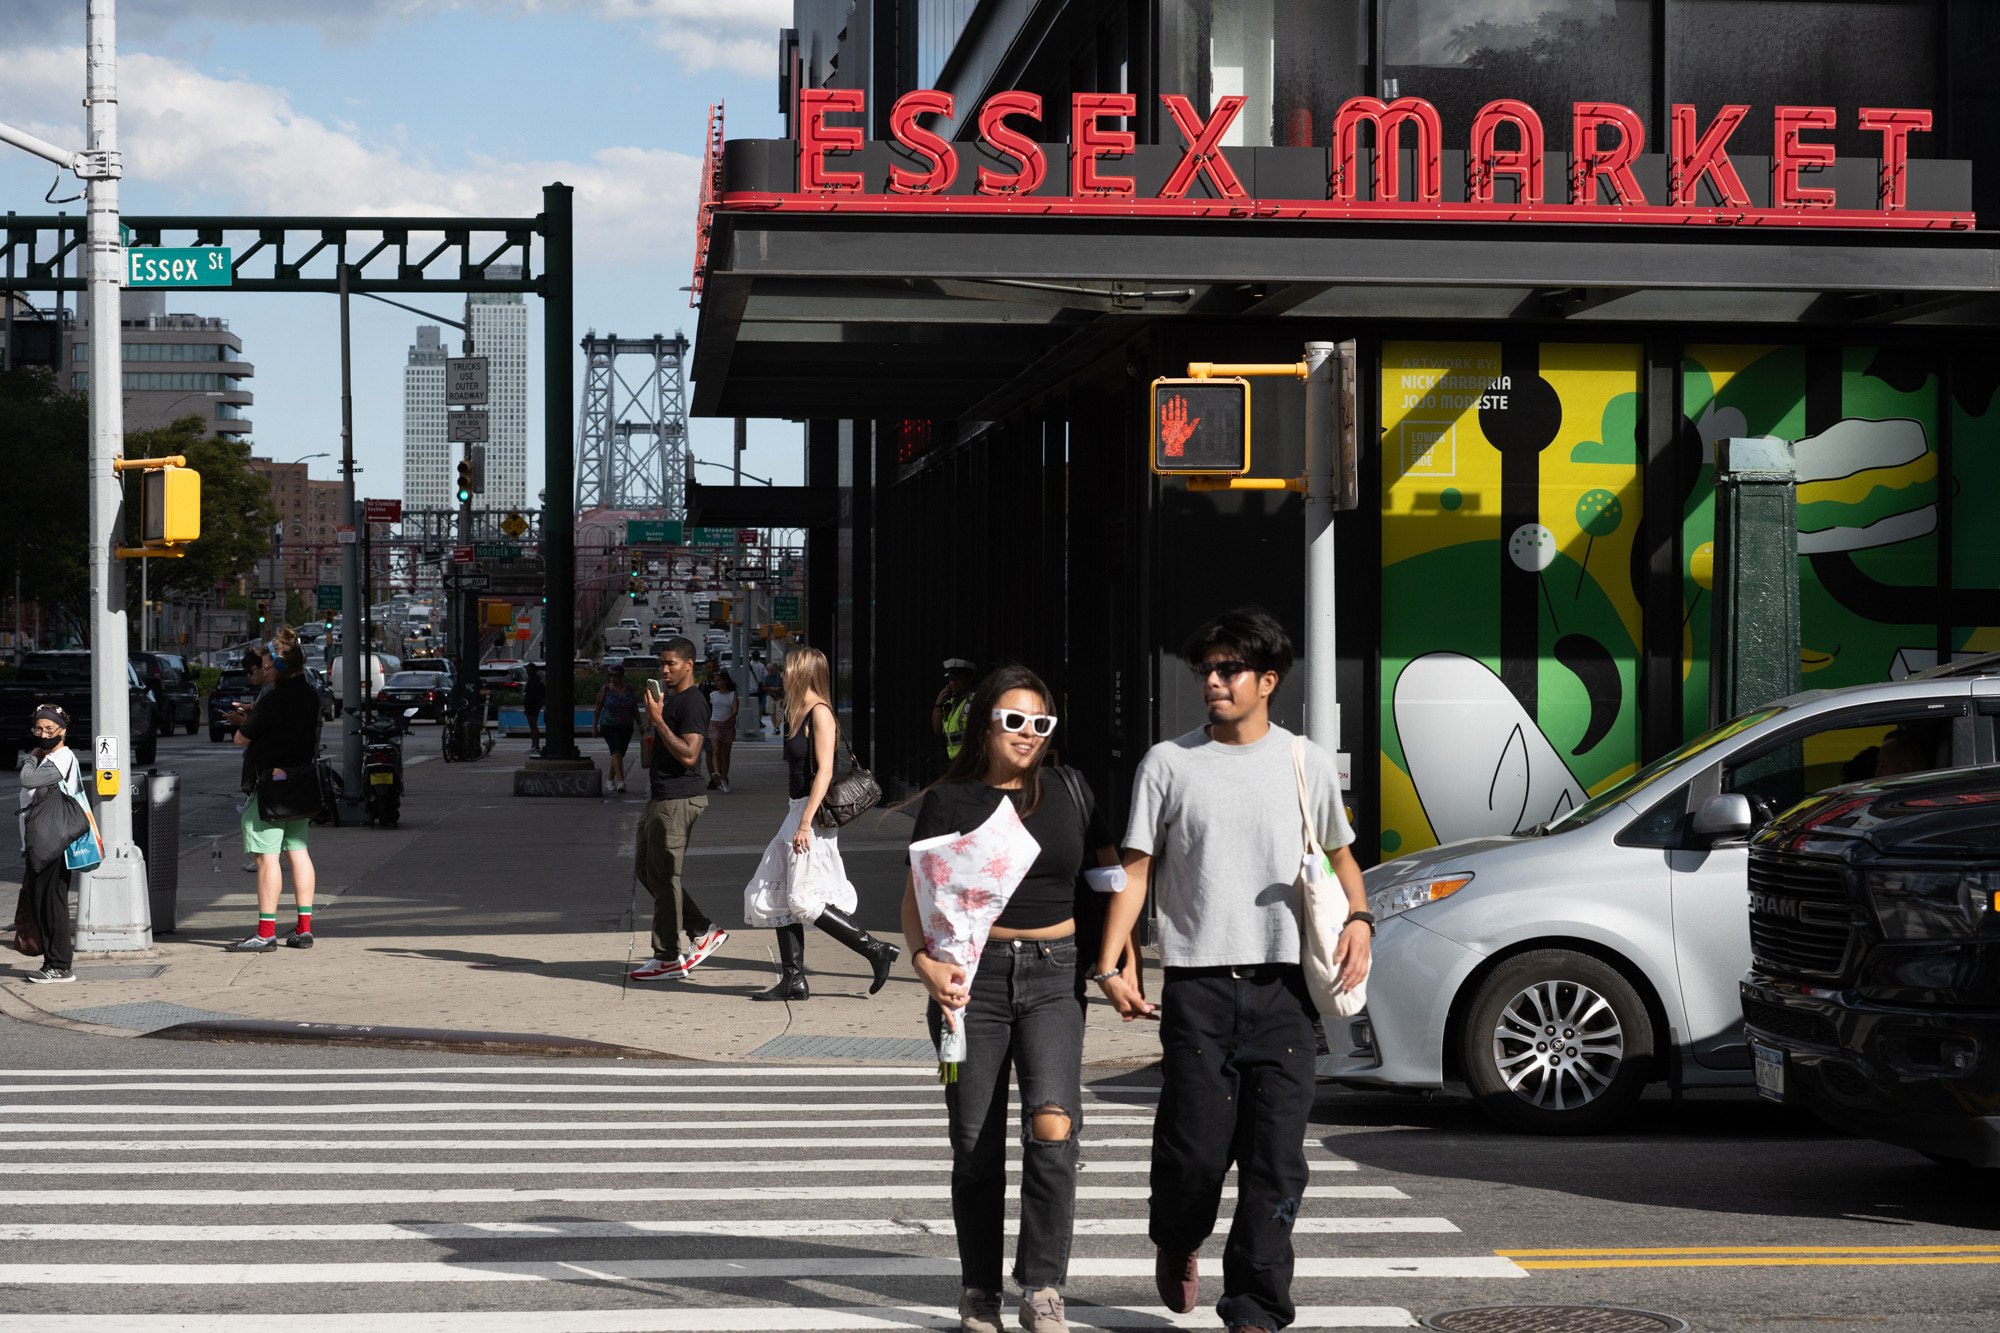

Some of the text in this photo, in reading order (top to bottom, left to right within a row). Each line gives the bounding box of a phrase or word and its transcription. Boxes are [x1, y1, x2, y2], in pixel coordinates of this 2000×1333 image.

[799, 89, 1933, 212] ESSEX MARKET
[131, 252, 224, 281] Essex St
[453, 362, 481, 370] TRUCKS
[1401, 358, 1471, 369] ARTWORK
[459, 372, 475, 380] USE
[455, 382, 479, 391] OUTER
[1401, 375, 1512, 391] NICK BARBARIA
[448, 391, 485, 400] ROADWAY
[1401, 394, 1508, 410] JOJO MODESTE
[1411, 431, 1446, 443] LOWER
[1411, 443, 1435, 455] EAST
[1411, 455, 1433, 467] SIDE
[476, 546, 509, 557] Norfolk
[472, 578, 485, 586] WAY
[1755, 895, 1797, 918] RAM
